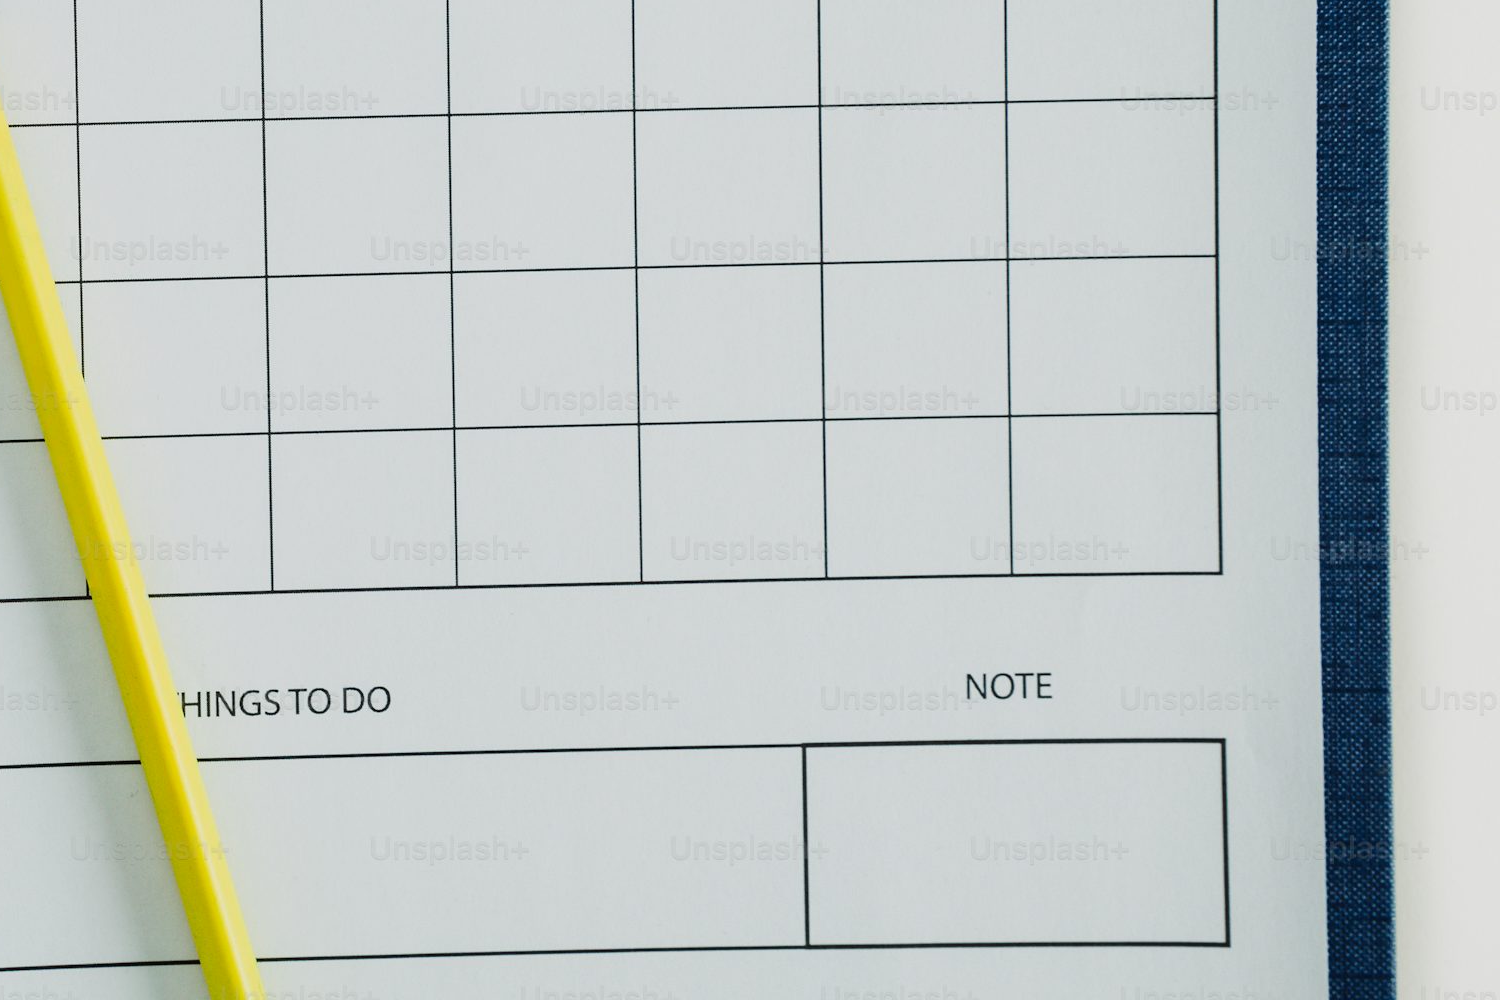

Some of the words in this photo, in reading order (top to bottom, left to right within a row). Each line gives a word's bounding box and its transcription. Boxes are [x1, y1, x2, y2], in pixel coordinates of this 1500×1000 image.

[966, 672, 1053, 700] NOTE
[177, 688, 281, 718] HINGS
[287, 687, 332, 715] TO
[342, 686, 391, 714] DO
